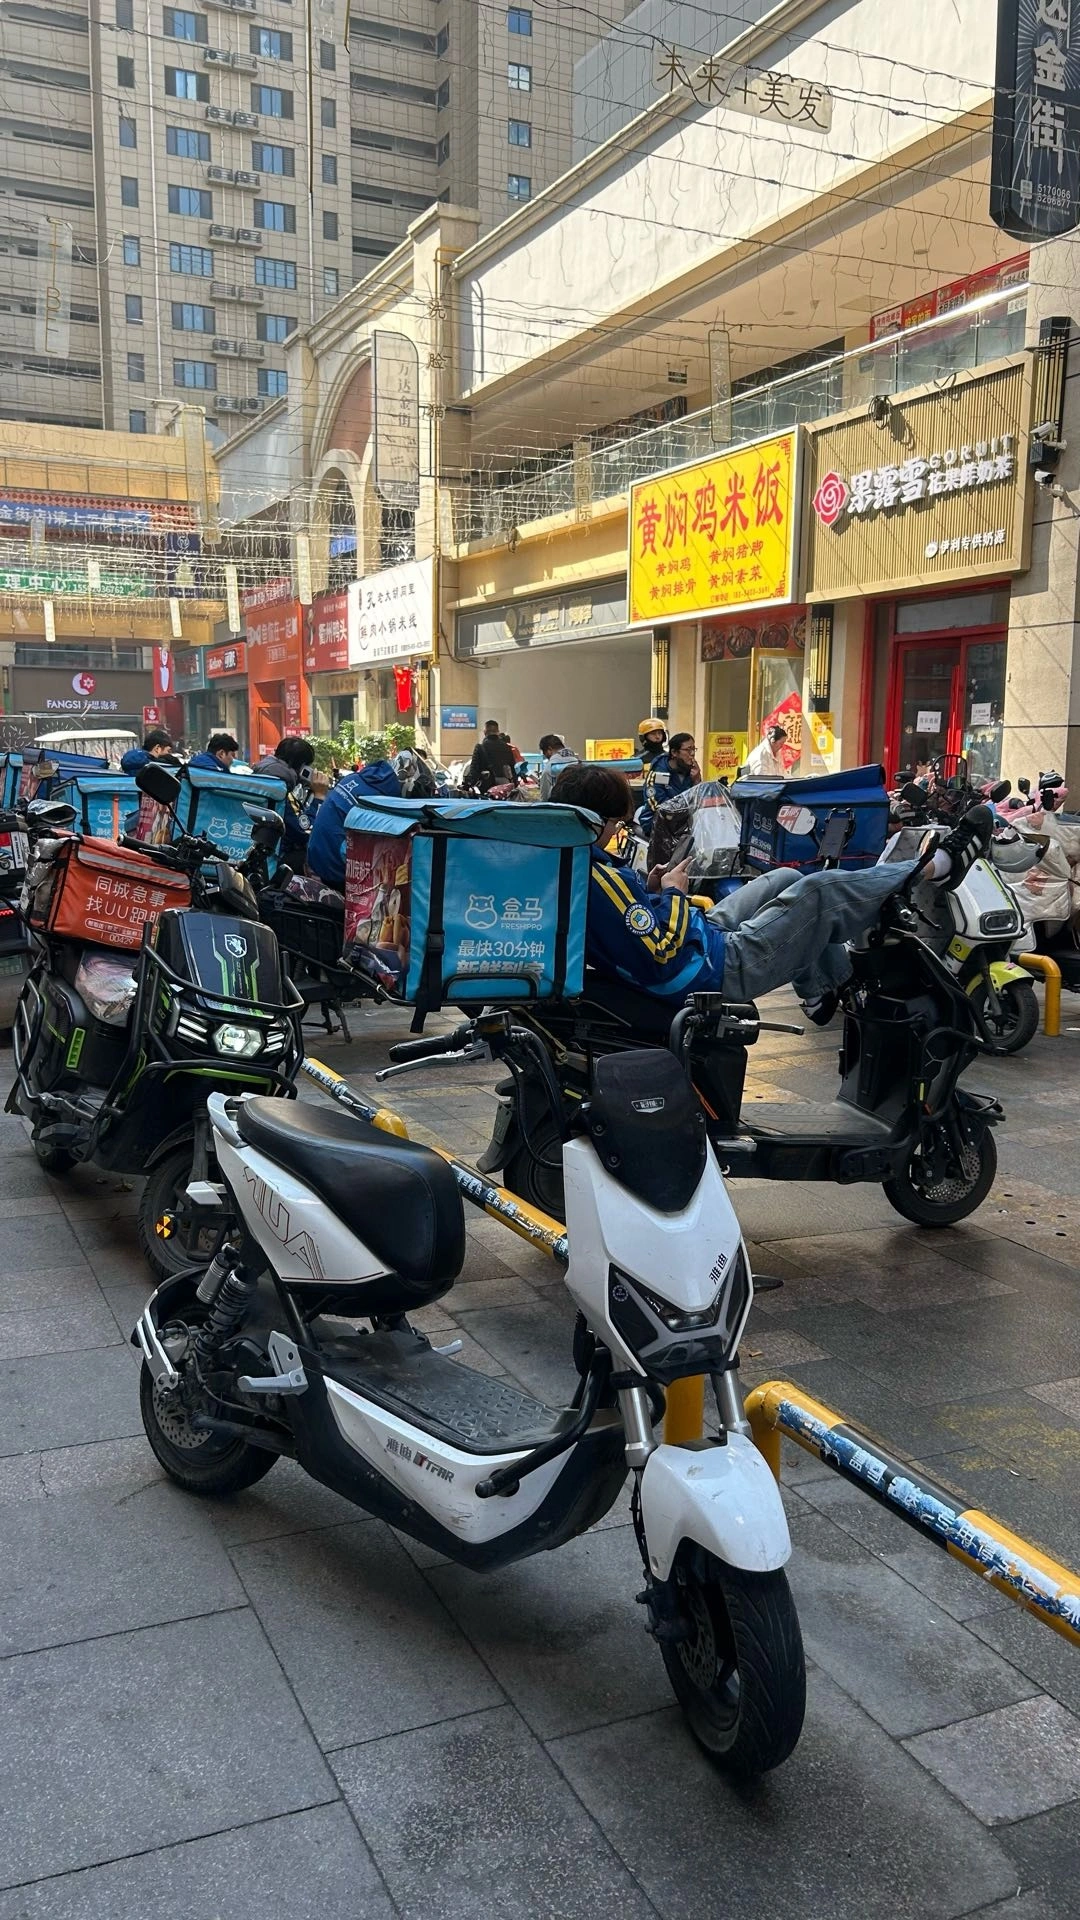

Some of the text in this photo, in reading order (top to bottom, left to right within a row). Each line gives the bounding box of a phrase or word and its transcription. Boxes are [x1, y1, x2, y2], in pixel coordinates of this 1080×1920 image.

[636, 462, 784, 560] 黄焖鸡米饭
[708, 539, 764, 566] 黄焖猪脚
[938, 528, 1008, 555] 伊利专供奶源
[655, 557, 691, 578] 黄焖鸡
[707, 563, 763, 590] 黄焖素菜
[649, 577, 697, 601] 黄焖排骨
[46, 699, 81, 709] FANGSI
[95, 874, 168, 908] 同城急事
[500, 897, 544, 922] 盒马
[500, 922, 544, 932] FRESHIPPO
[457, 939, 546, 959] 最快30分钟
[708, 1252, 729, 1286] 雅迪
